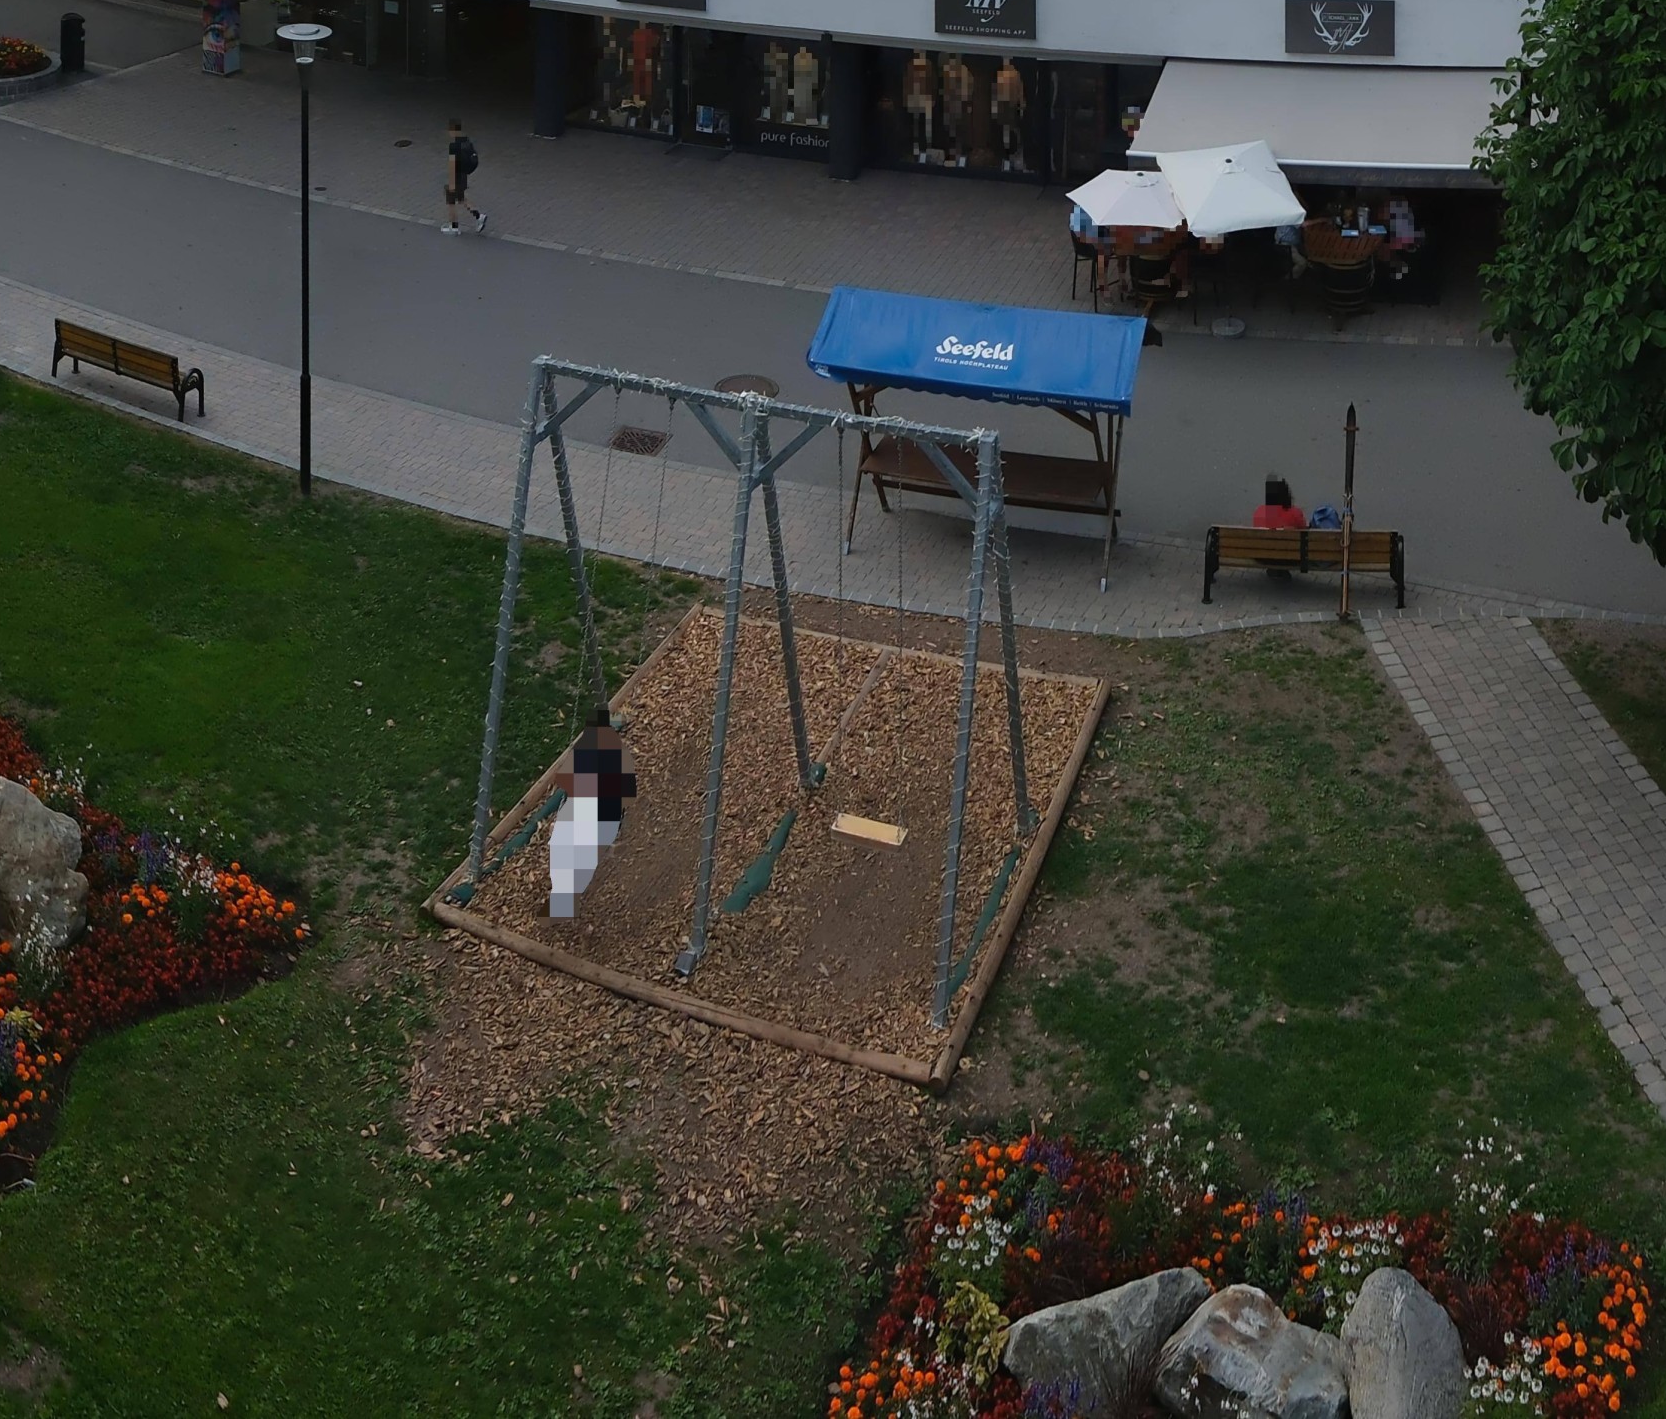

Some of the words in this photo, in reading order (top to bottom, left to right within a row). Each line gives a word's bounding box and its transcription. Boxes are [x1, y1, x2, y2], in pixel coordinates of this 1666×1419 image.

[945, 24, 974, 32] SEEFELD
[760, 132, 786, 143] pure
[935, 335, 1014, 362] Seefeld
